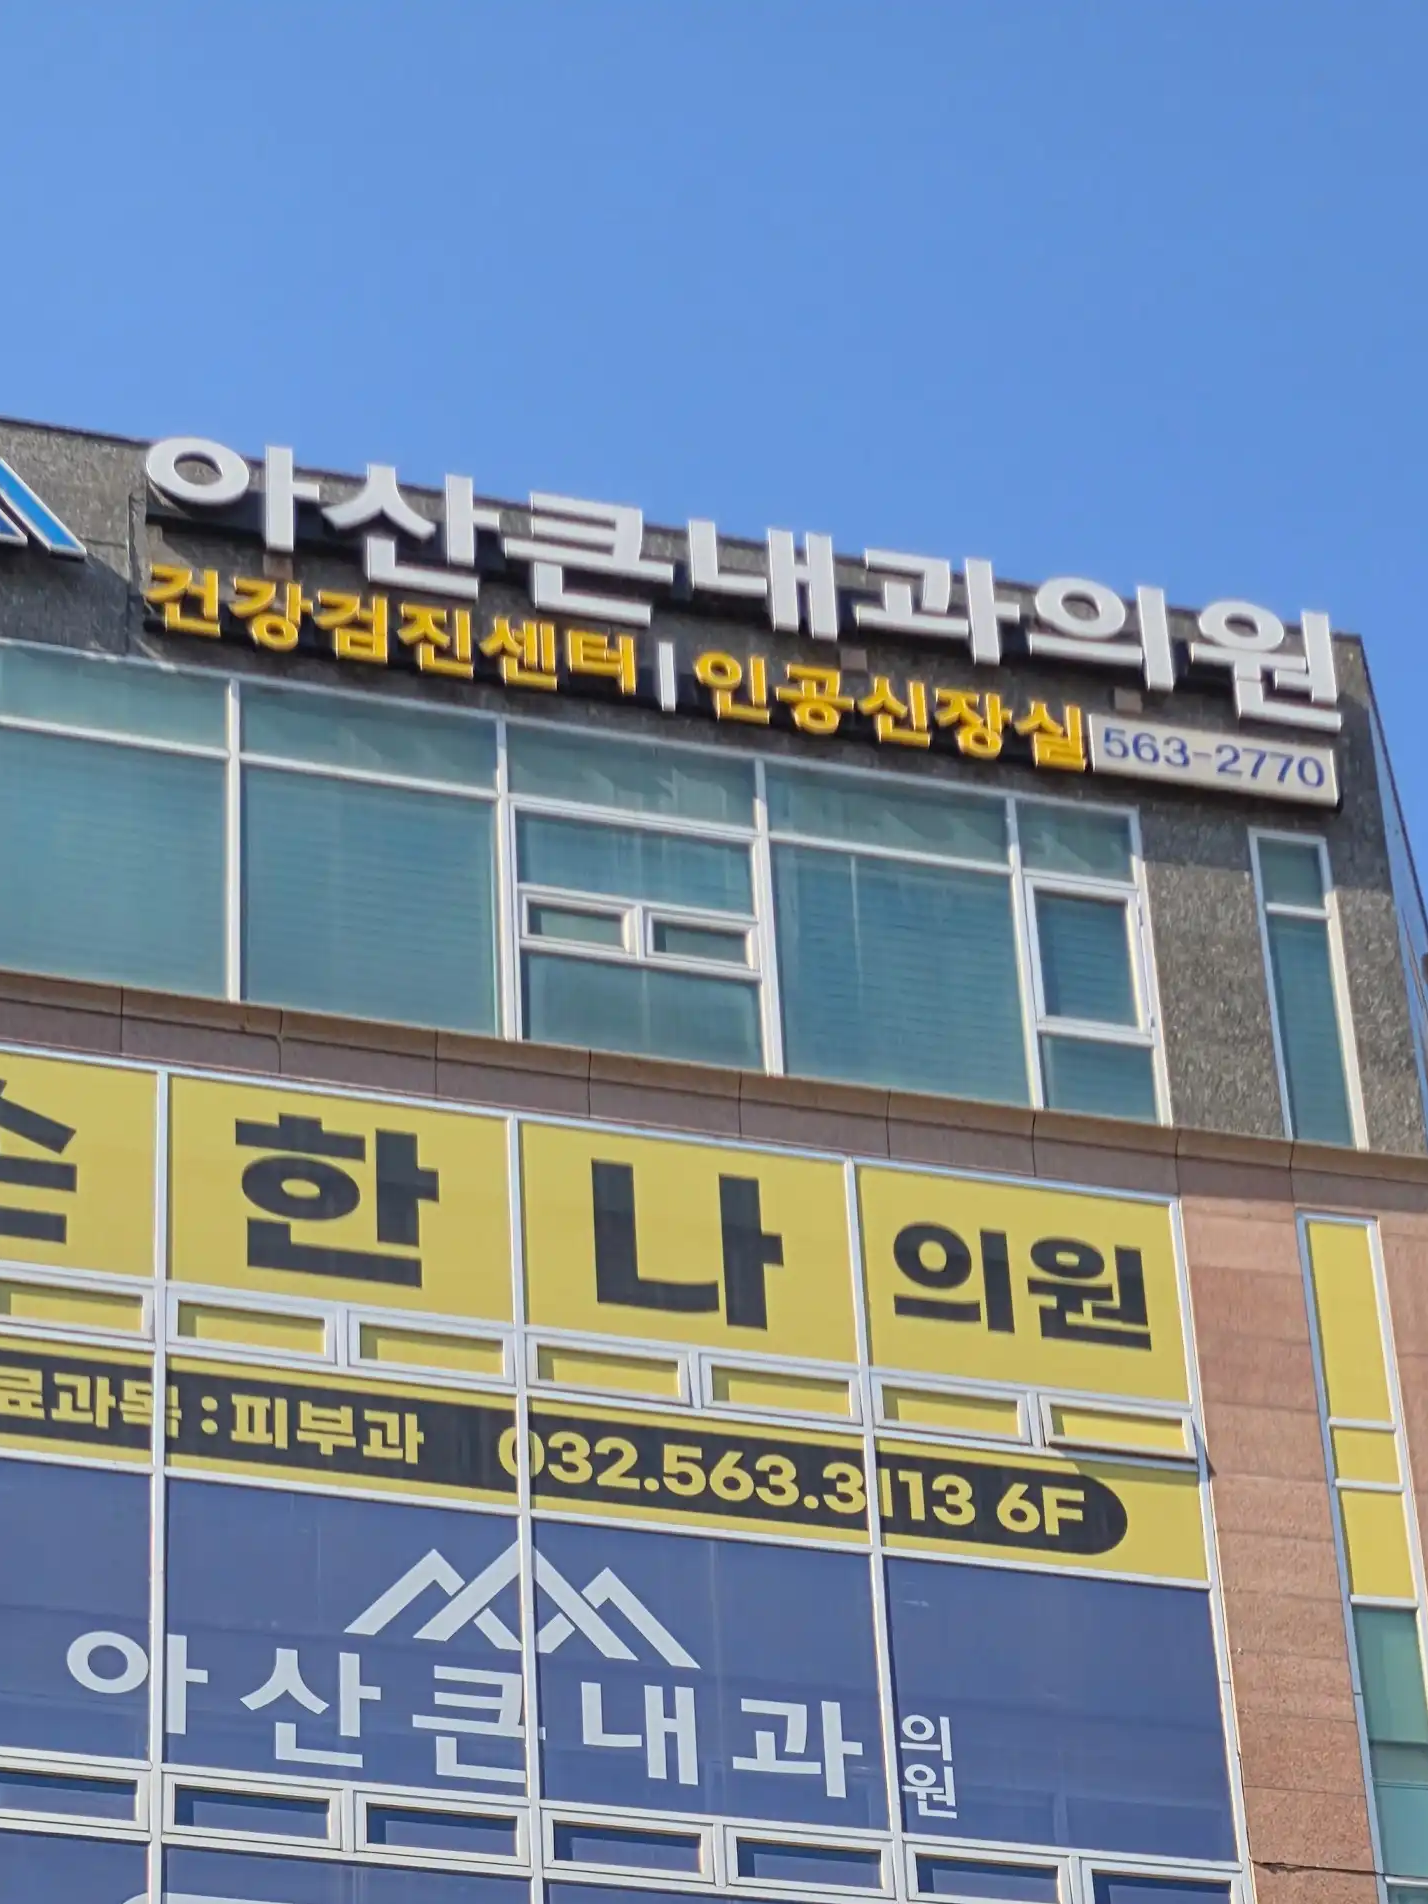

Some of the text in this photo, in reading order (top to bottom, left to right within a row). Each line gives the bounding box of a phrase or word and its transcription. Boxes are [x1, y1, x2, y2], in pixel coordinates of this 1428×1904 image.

[144, 434, 1344, 733] 아산큰내과의원
[148, 562, 1329, 792] 건강검진센터 인공신장실 563-2770
[892, 1217, 1152, 1352] 의원
[996, 1480, 1086, 1538] 6F
[67, 1626, 863, 1800] 아산큰내과
